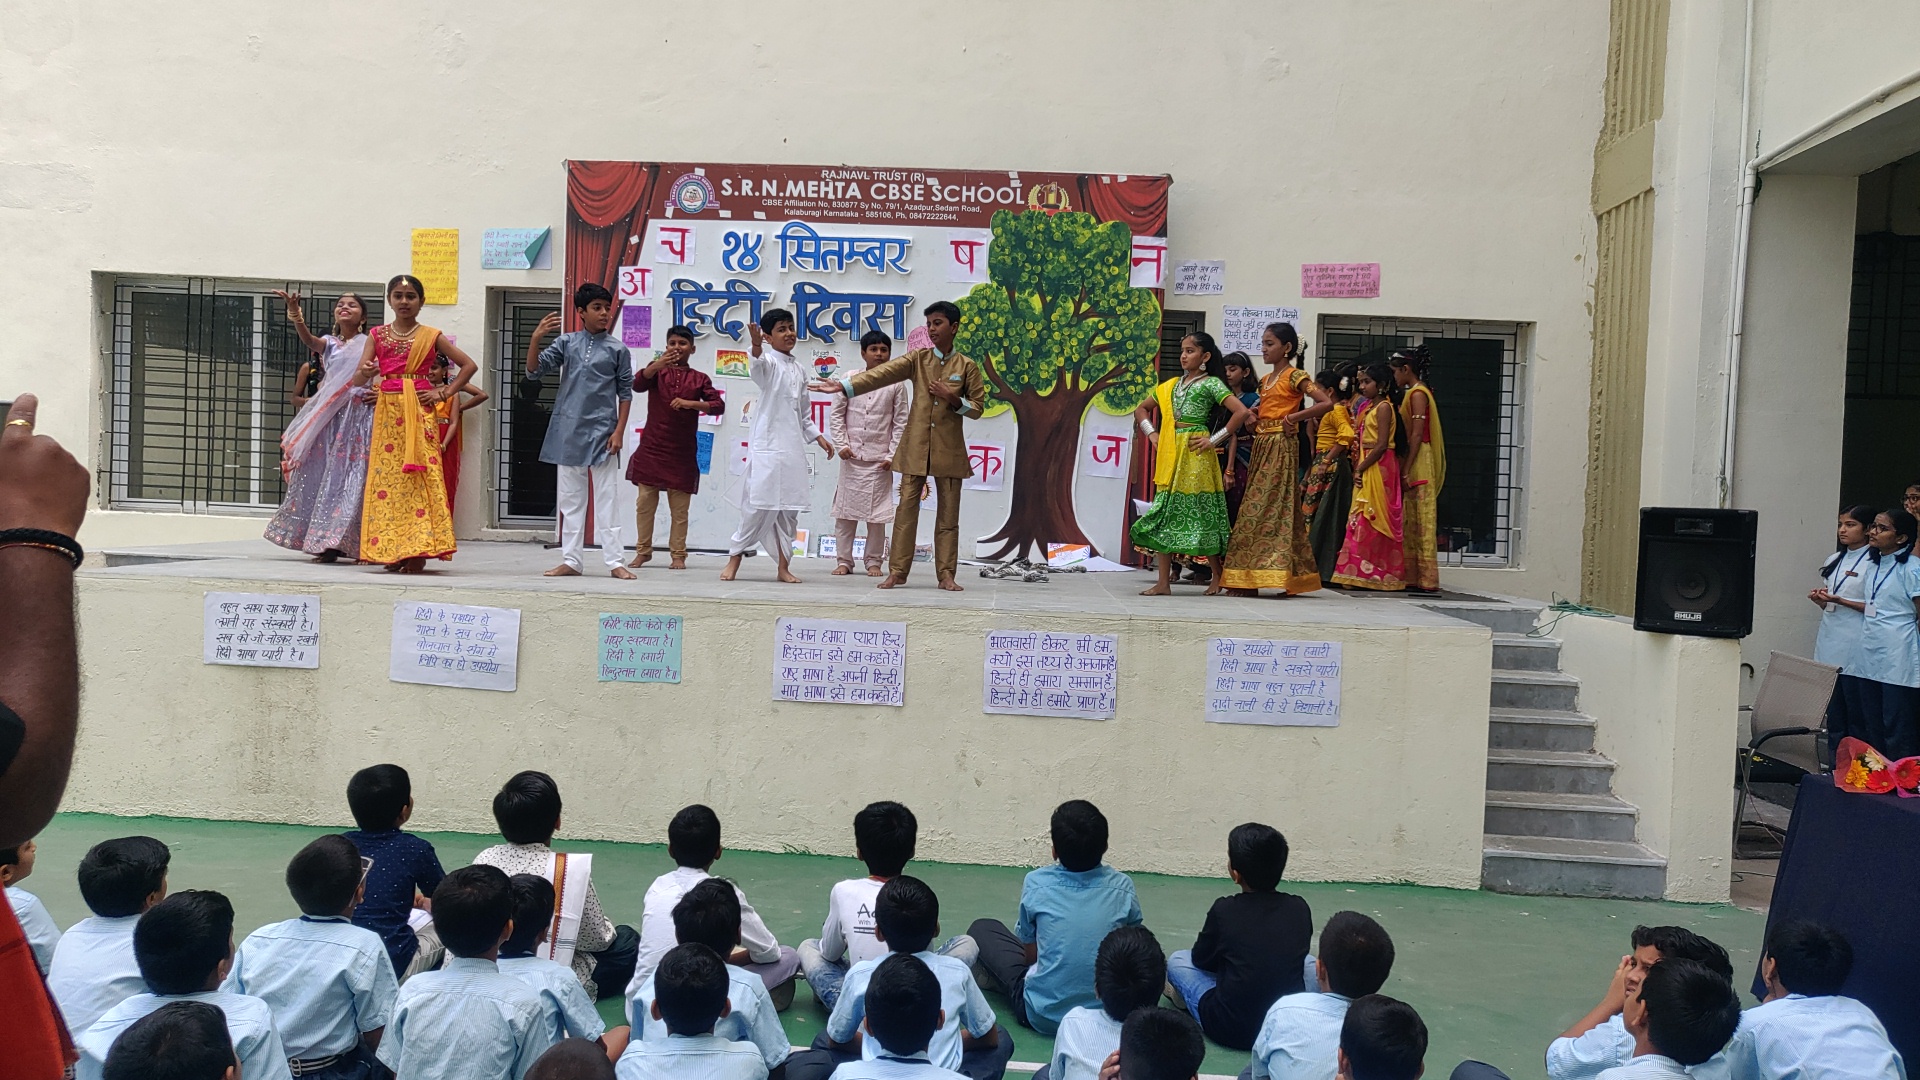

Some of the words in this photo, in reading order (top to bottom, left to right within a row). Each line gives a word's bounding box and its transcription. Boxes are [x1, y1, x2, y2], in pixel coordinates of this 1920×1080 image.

[821, 170, 870, 181] RAJNAVL
[872, 171, 908, 182] TRUST
[910, 172, 925, 183] (R)
[720, 178, 862, 200] S.R.N.MEHTA
[870, 182, 925, 201] CBSE
[931, 185, 1025, 205] SCHOOL
[784, 199, 816, 207] Affiliation
[832, 201, 858, 209] 830877
[860, 202, 869, 210] Sy
[961, 205, 982, 214] Road,
[784, 208, 822, 218] Kalaburagi
[823, 209, 859, 218] Karnataka
[660, 227, 691, 264] च
[722, 230, 764, 273] १४
[774, 221, 912, 274] सितम्बर
[950, 240, 985, 274] ष
[1131, 244, 1168, 284] न
[621, 268, 653, 297] अ
[667, 278, 776, 342] हिंदी
[789, 281, 915, 344] दिवस
[1091, 434, 1128, 467] ज
[968, 445, 1003, 482] क
[1674, 611, 1702, 621] AHUJA
[821, 630, 847, 644] हमारा
[1042, 634, 1070, 650] होकर
[1076, 635, 1093, 653] भी
[847, 650, 863, 663] हम
[864, 650, 890, 665] कहते
[1304, 642, 1332, 657] हमारी
[803, 668, 825, 681] भाषा
[837, 666, 868, 683] अपनी
[990, 668, 1017, 685] हिन्दी
[1019, 669, 1032, 686] ही
[1034, 675, 1062, 688] हमारा
[804, 686, 827, 699] भाषा
[851, 689, 866, 702] हम
[990, 688, 1017, 705] हिन्दी
[1031, 688, 1043, 707] ही
[1047, 691, 1073, 708] हमारे
